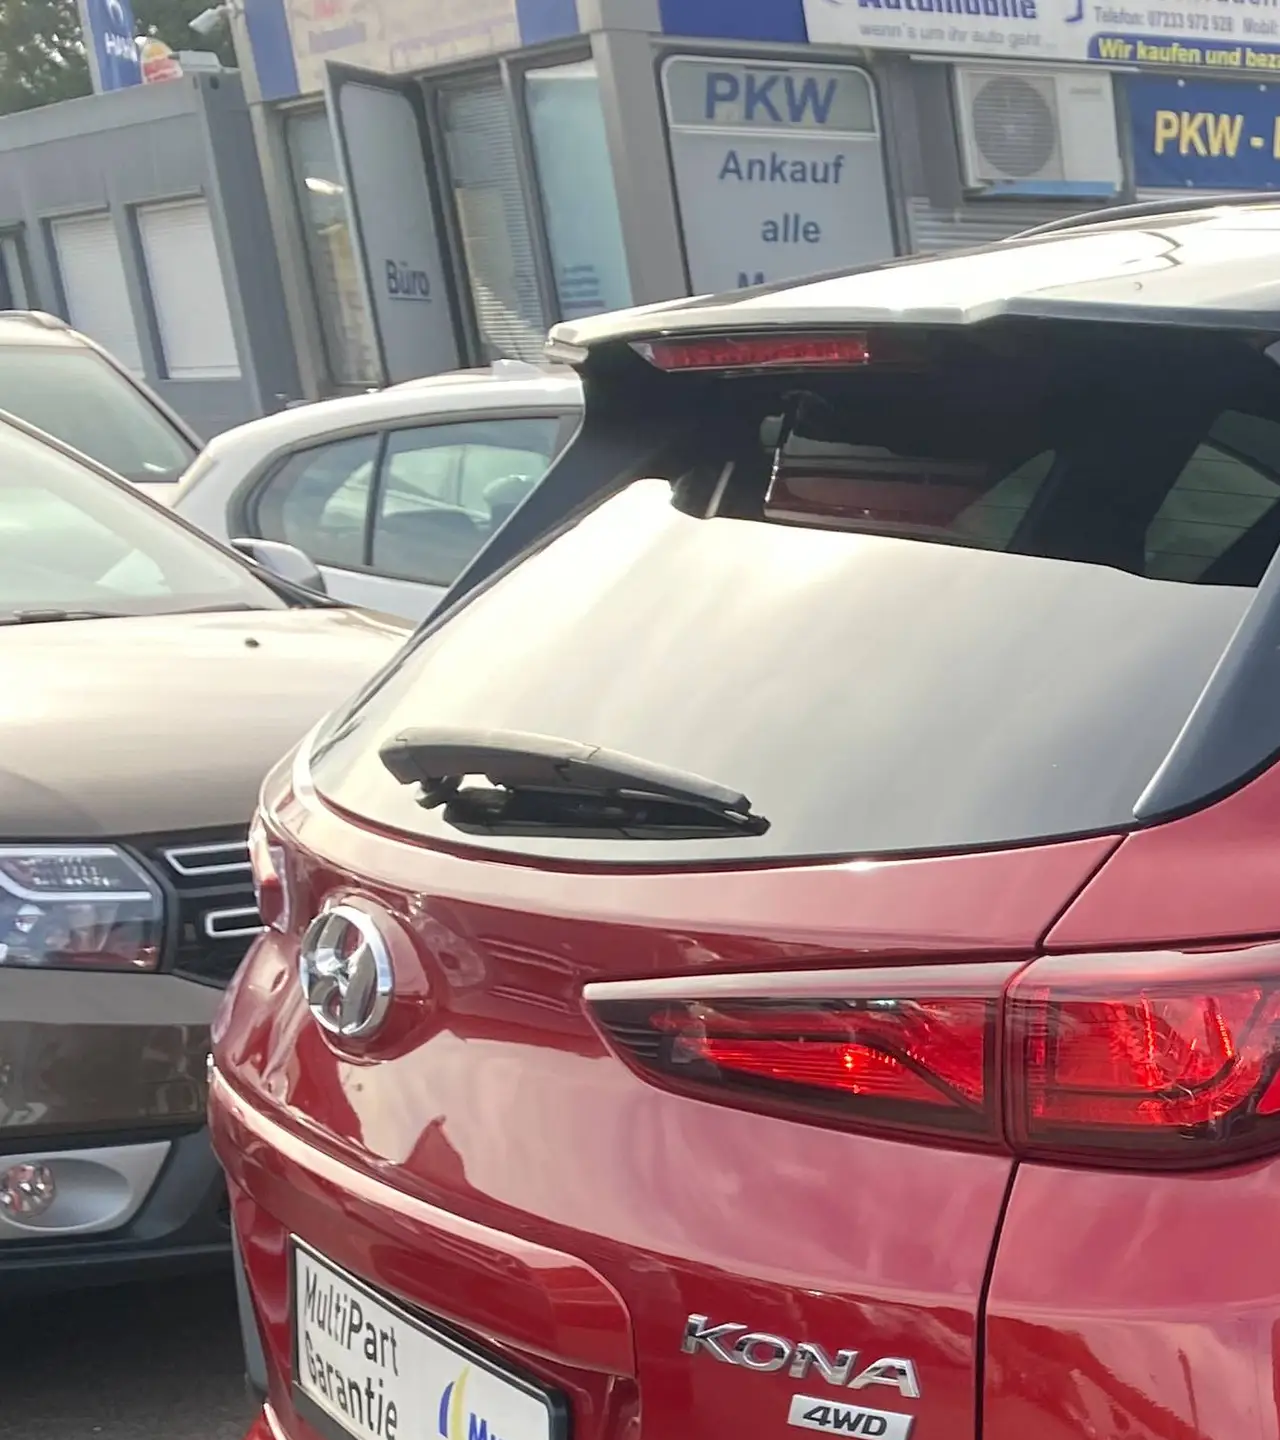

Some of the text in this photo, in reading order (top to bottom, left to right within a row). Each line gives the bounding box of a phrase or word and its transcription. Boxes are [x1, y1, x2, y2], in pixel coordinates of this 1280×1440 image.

[1098, 37, 1133, 59] Wir
[1136, 41, 1200, 64] kaufen
[1205, 47, 1242, 68] und
[705, 72, 838, 124] PKW
[1153, 109, 1243, 160] PKW
[718, 149, 846, 184] Ankauf
[760, 213, 822, 244] alle
[385, 259, 431, 297] Büro
[304, 1266, 399, 1377] MultiPart
[680, 1313, 921, 1399] KONA
[802, 1405, 888, 1438] 4WD
